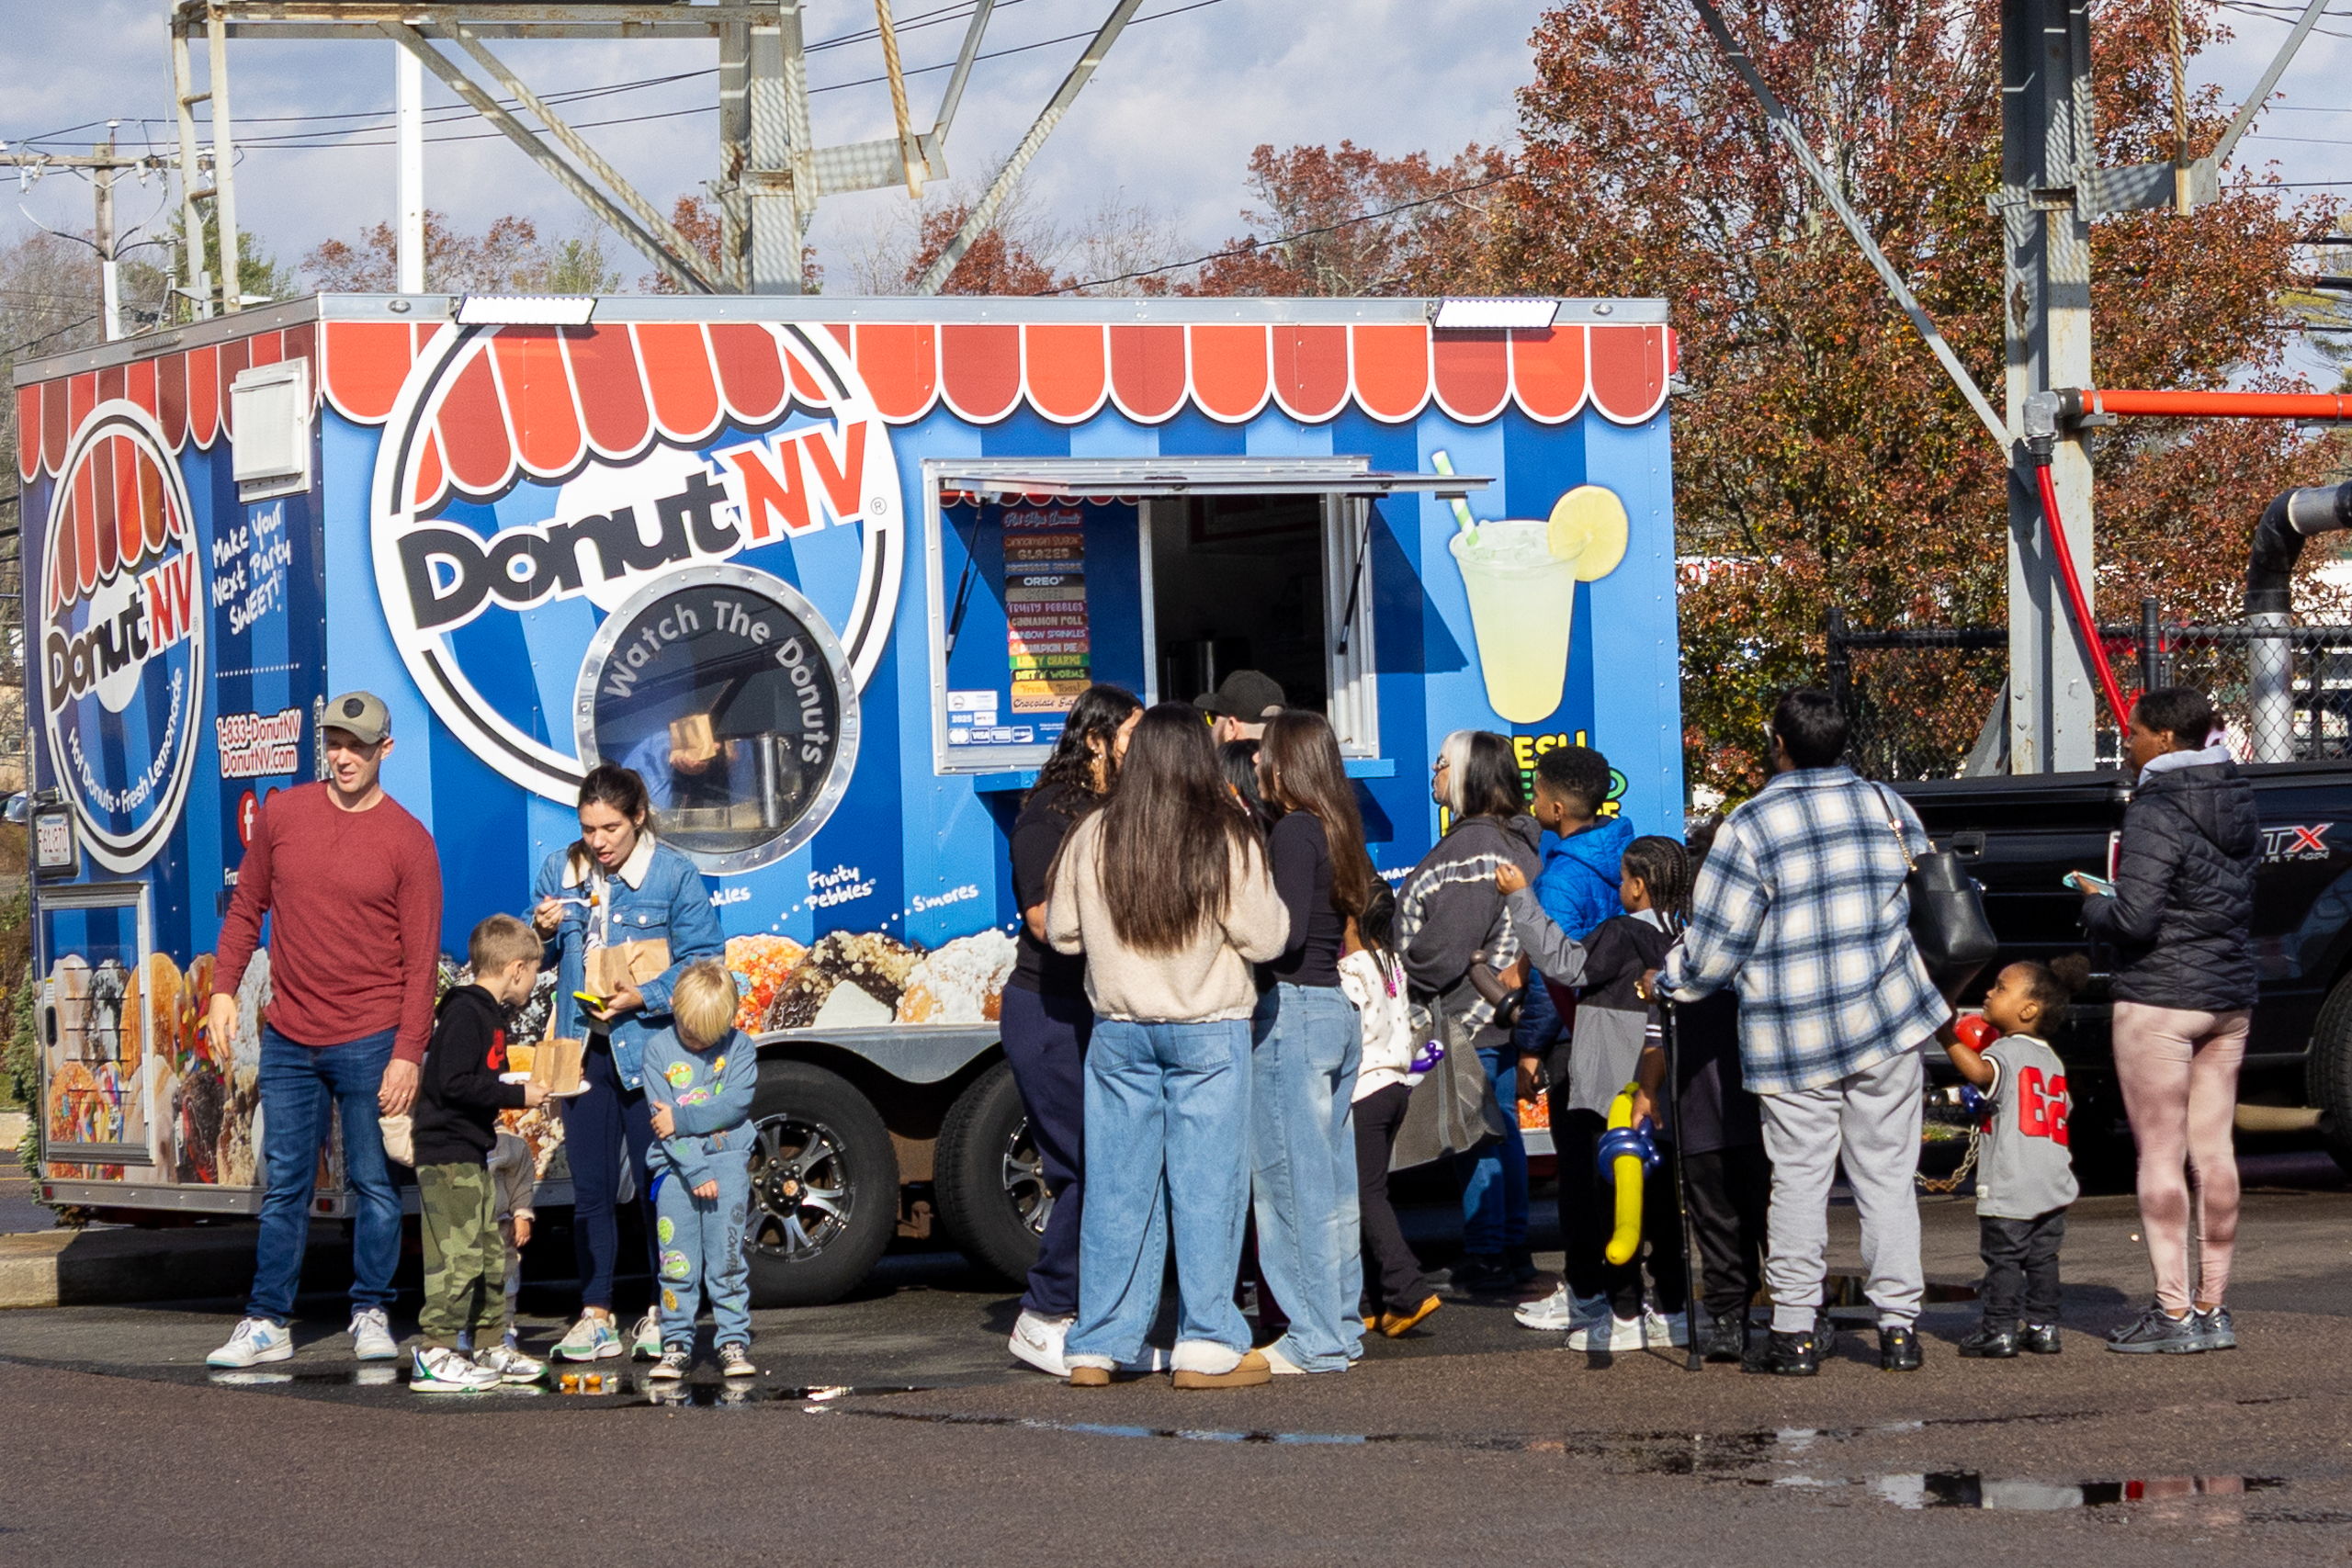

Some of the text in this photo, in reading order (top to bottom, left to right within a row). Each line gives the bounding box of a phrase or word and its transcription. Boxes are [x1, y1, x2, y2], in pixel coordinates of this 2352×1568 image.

[212, 502, 282, 569] Make Your
[397, 420, 867, 630] DonutNV
[212, 535, 292, 609] Next Party
[230, 570, 282, 636] SWEET!
[47, 553, 193, 712] DonutNV
[604, 600, 830, 764] Watch The Donuts
[68, 667, 182, 813] Hot Donuts Fresh Lemonade
[217, 711, 300, 747] 1-833-DonutNV
[222, 746, 296, 774] DonutNV.com
[804, 880, 873, 910] Pebbles
[808, 864, 860, 890] Fruity
[912, 884, 978, 912] S'mores
